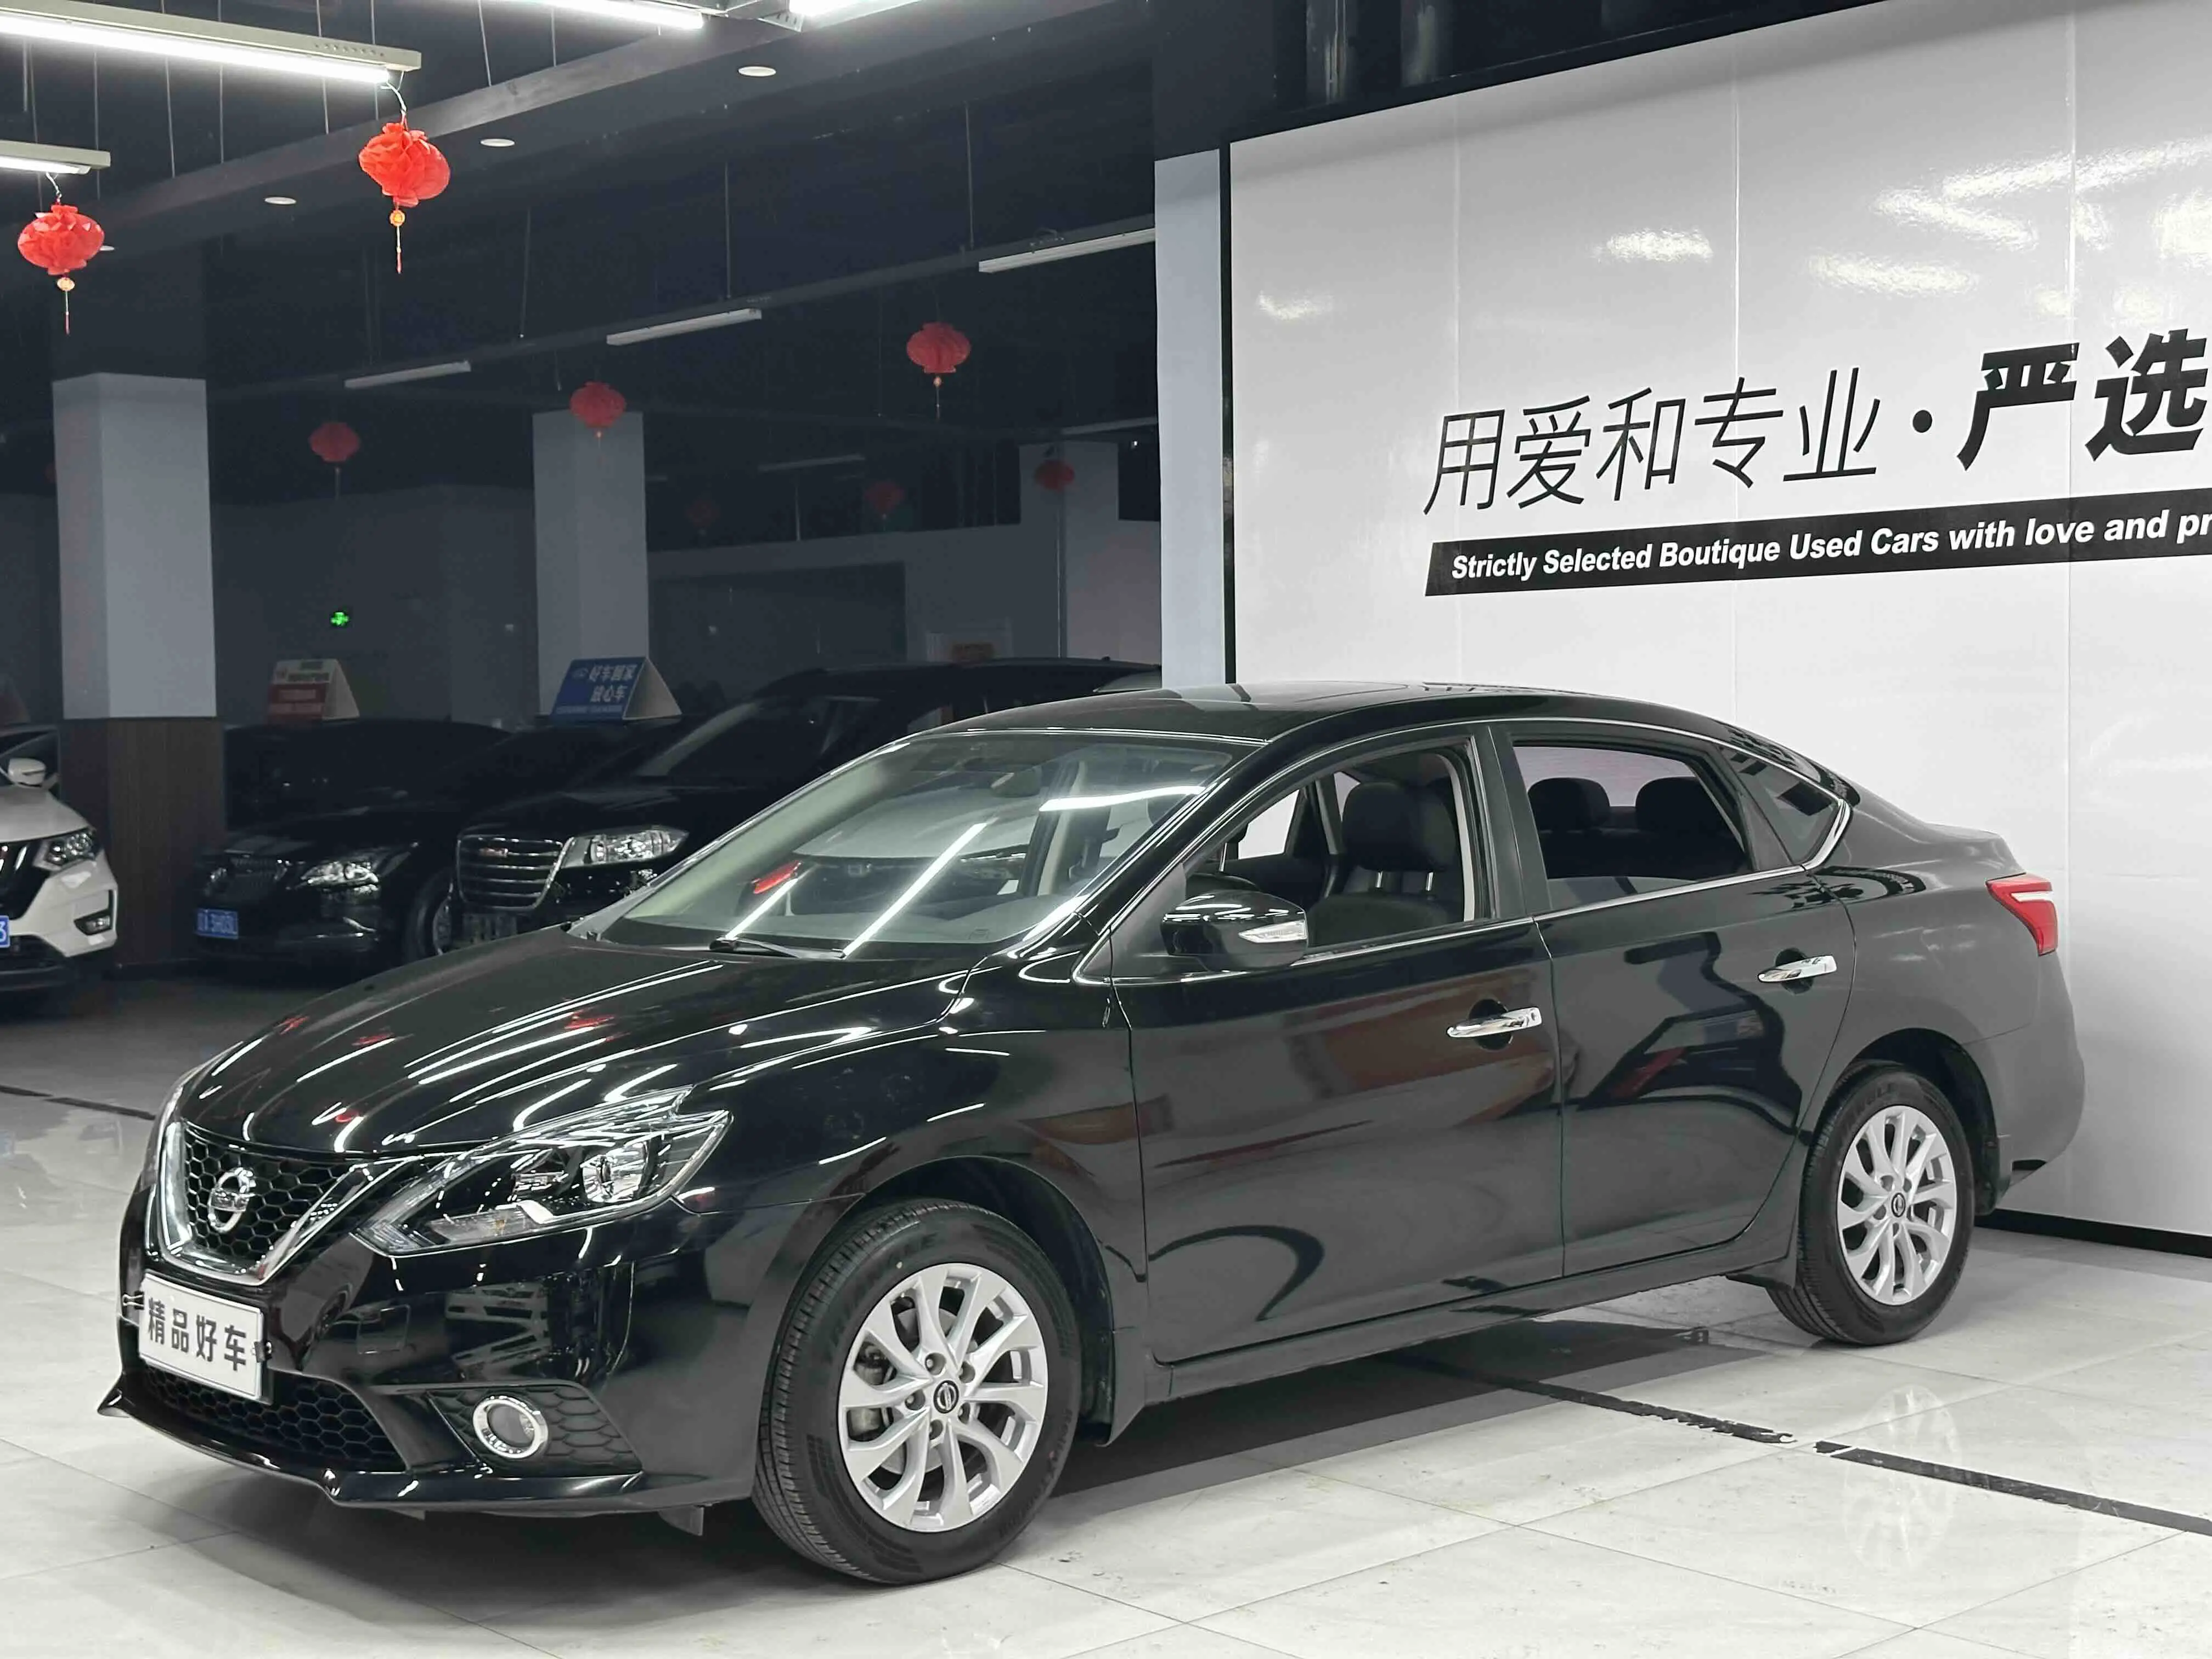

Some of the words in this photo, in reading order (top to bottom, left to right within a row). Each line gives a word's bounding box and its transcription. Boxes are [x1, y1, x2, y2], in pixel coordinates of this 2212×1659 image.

[1452, 551, 1537, 582] Strictly
[1543, 543, 1653, 574] Selected
[1659, 538, 1780, 569] Boutique
[1790, 529, 1863, 560] Used
[1871, 528, 1939, 555] Cars
[1949, 520, 2015, 550] with
[2025, 518, 2095, 546] love
[2104, 509, 2170, 541] and
[148, 1297, 246, 1372] 精品好车
